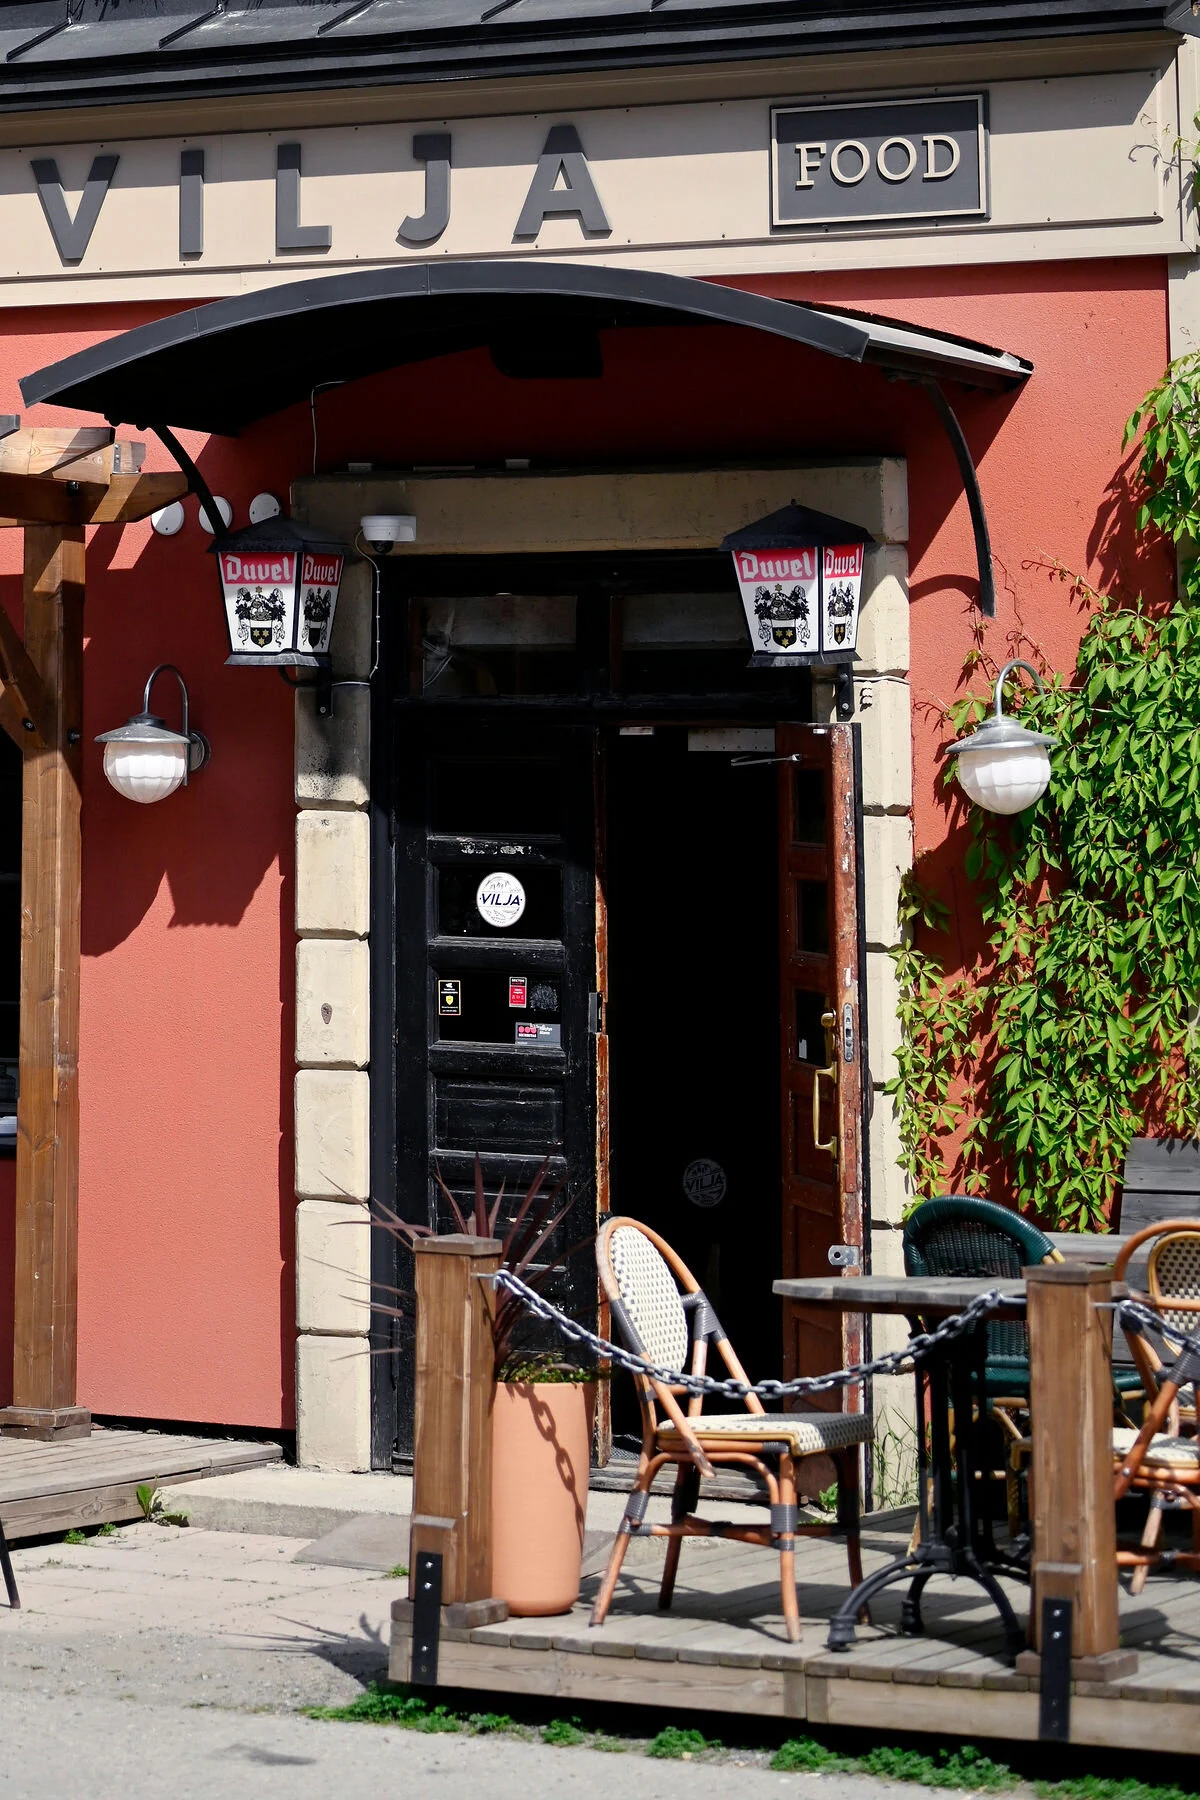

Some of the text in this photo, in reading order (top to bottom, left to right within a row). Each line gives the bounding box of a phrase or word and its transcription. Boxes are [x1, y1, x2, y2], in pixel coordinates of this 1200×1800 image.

[794, 134, 961, 188] FOOD
[30, 124, 613, 267] VILJA
[225, 554, 291, 582] Duvel
[303, 554, 339, 583] Duvel
[739, 550, 814, 580] Duvel
[824, 546, 861, 577] Duvel
[481, 892, 521, 906] VILJA
[685, 1172, 723, 1193] VILJA
